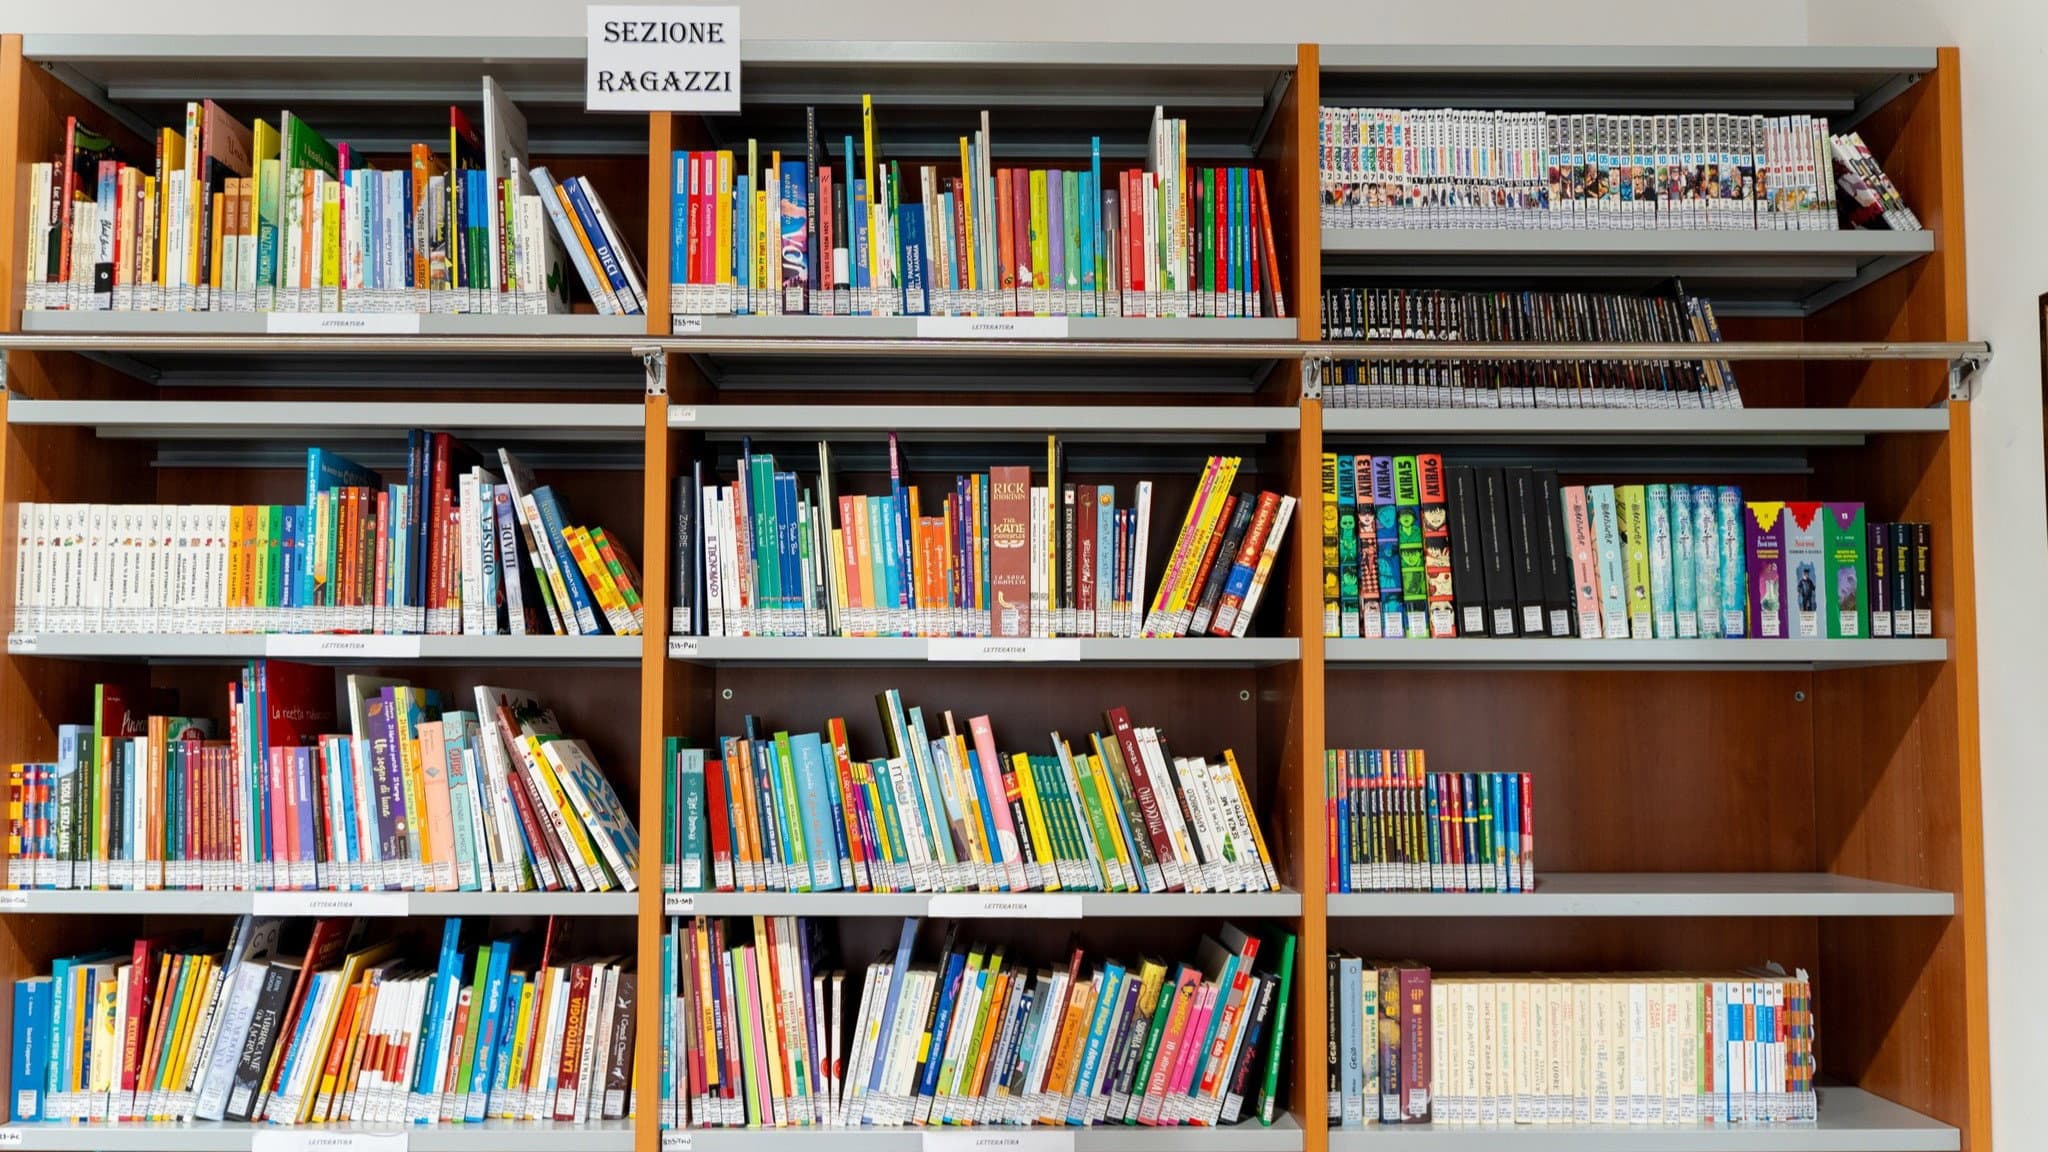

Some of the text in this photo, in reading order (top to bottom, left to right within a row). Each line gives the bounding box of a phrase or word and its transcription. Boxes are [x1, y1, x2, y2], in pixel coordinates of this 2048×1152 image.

[604, 21, 725, 44] SEZIONE
[598, 70, 732, 93] RAGAZZI
[416, 208, 425, 231] STORIE
[597, 246, 618, 277] DIECI
[993, 482, 1025, 495] RICK
[993, 492, 1026, 501] RIORDAN
[679, 514, 688, 548] ZOMBIE
[993, 523, 1026, 535] KANE
[1250, 509, 1269, 546] ROWLING
[482, 515, 494, 575] ODISSEA
[501, 524, 516, 568] ILIADE
[708, 536, 719, 598] IL TECNOMAGO
[322, 642, 365, 650] LETTERATURA
[272, 705, 281, 720] La
[124, 1016, 138, 1073] PICCOLE DONNE
[562, 997, 582, 1073] LA MITOLOGIA
[308, 1138, 353, 1146] LETTERATURA
